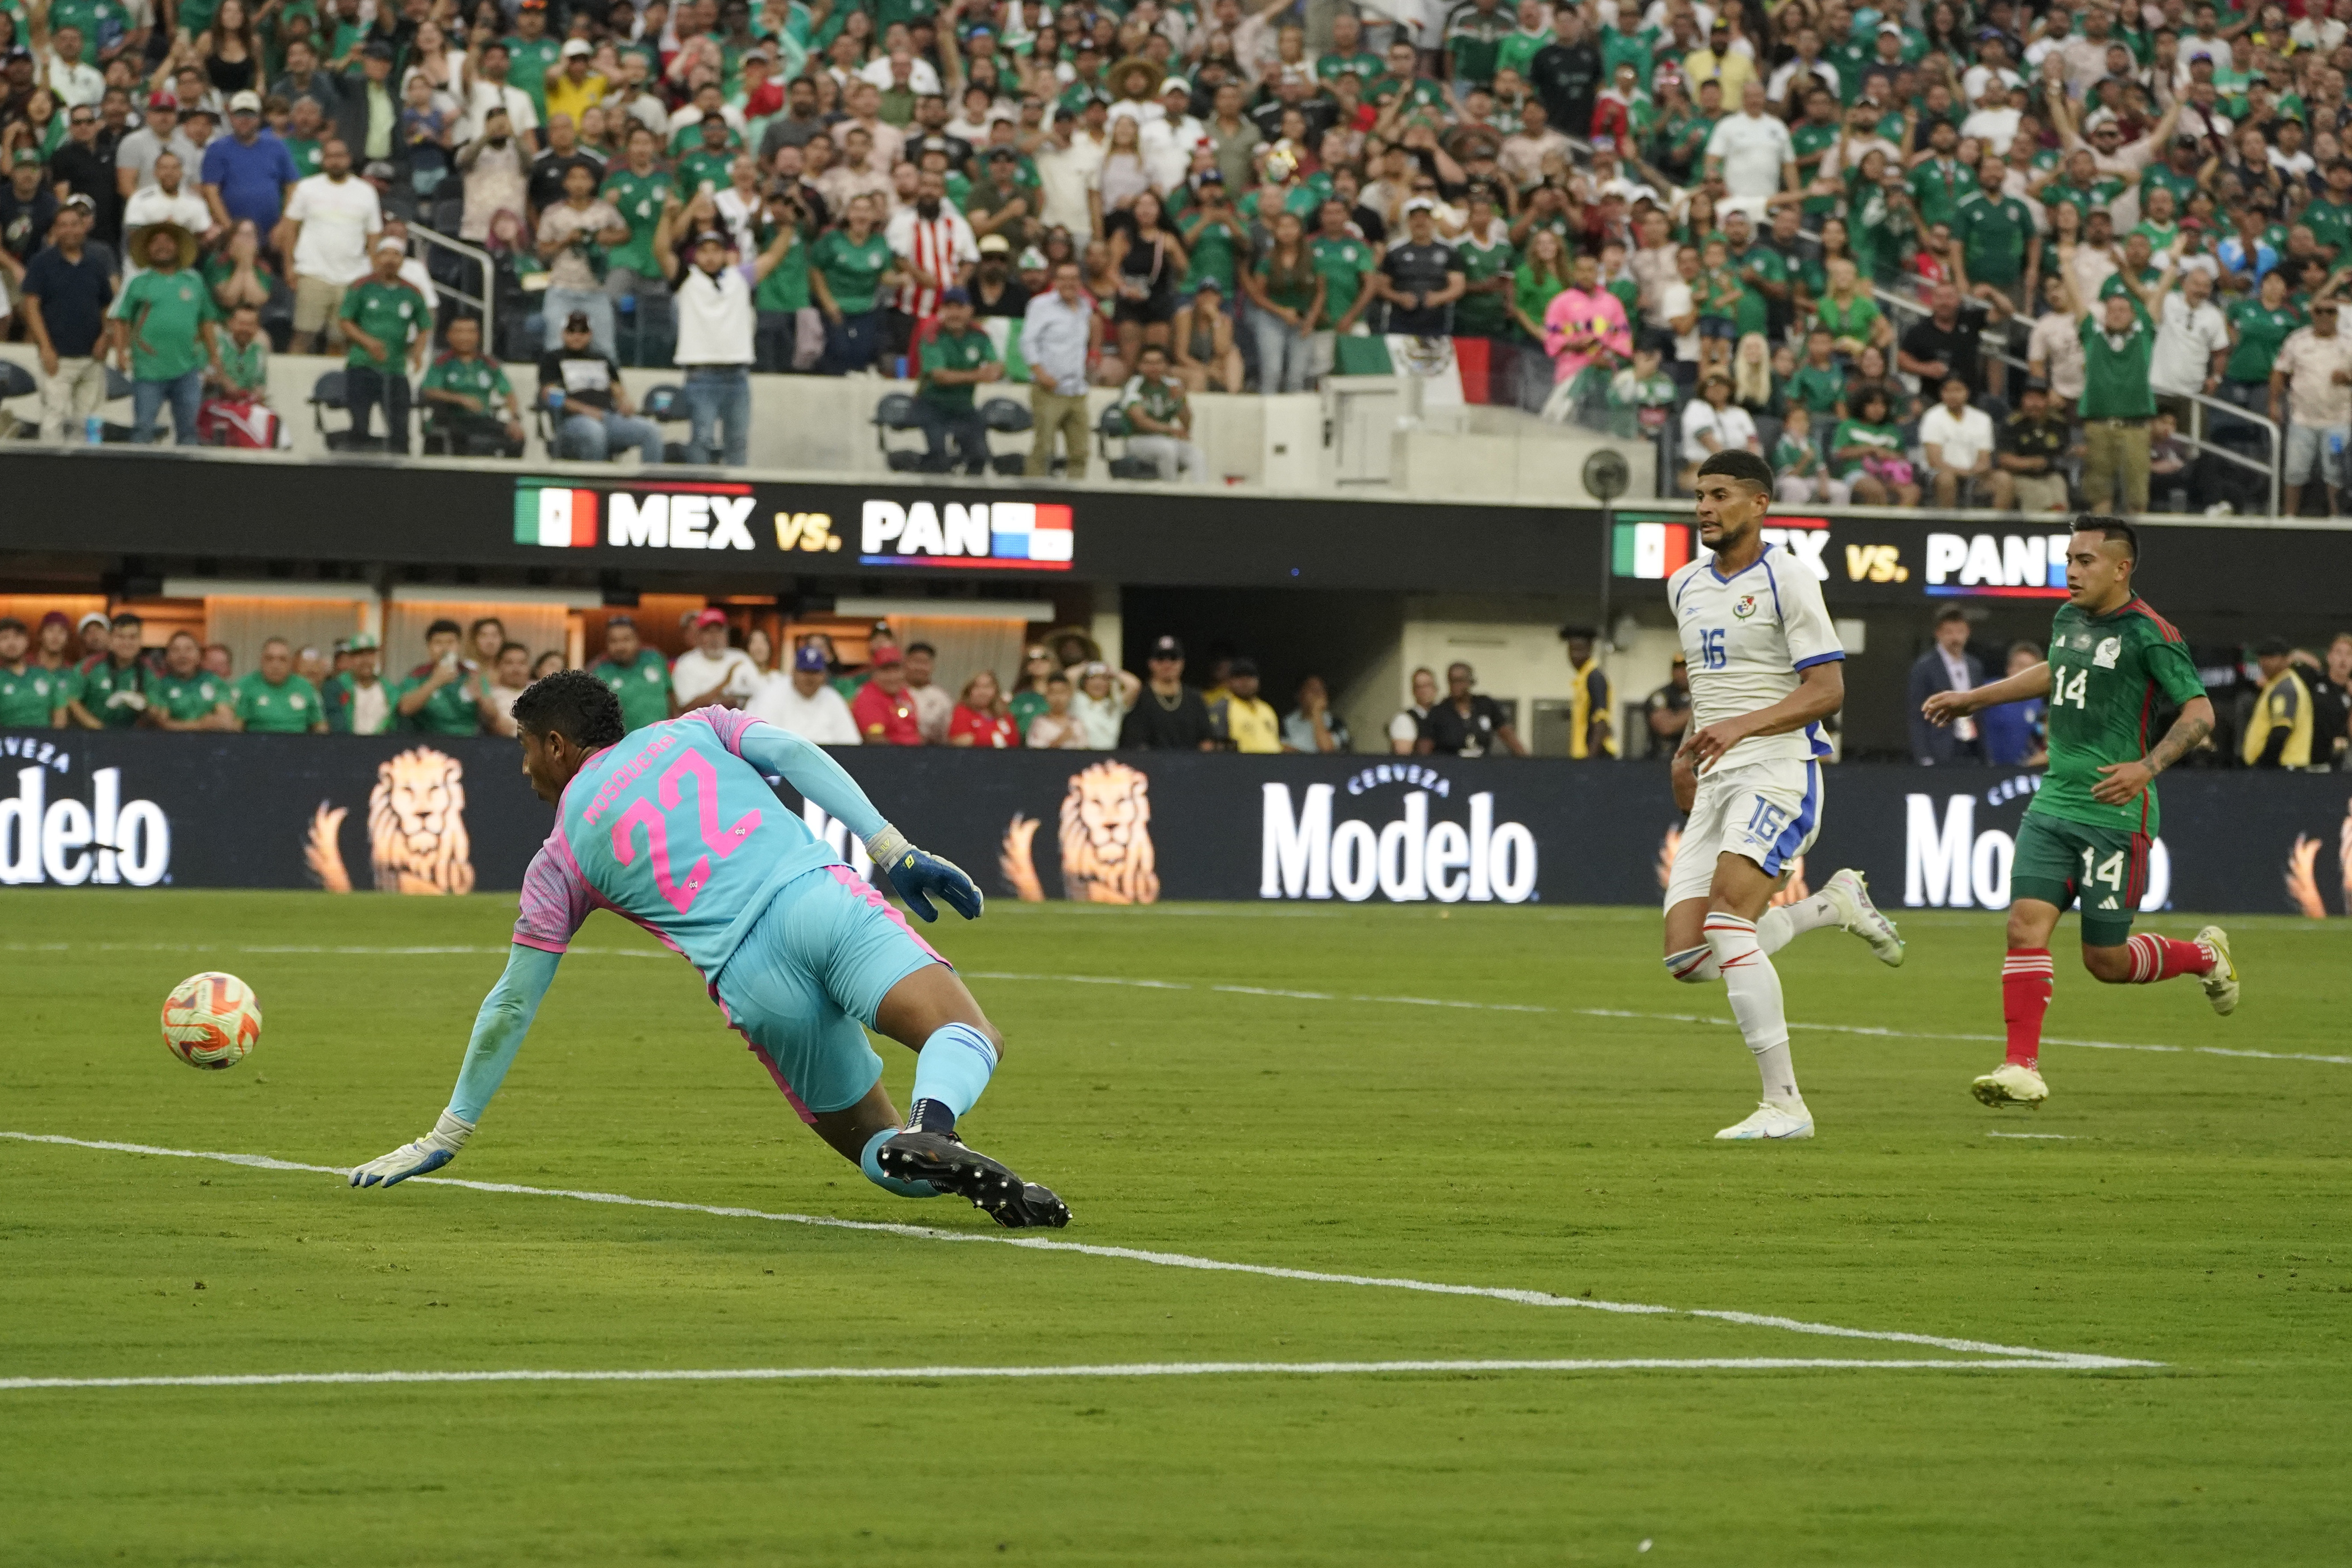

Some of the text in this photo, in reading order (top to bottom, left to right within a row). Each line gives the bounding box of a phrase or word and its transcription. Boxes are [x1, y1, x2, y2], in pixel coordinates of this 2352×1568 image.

[608, 492, 757, 551] MEX
[861, 499, 990, 556] PAN
[1925, 533, 2047, 586] PAN
[1700, 628, 1727, 670] 16
[2053, 665, 2088, 709] 14
[0, 736, 70, 773] VEZA
[583, 735, 677, 826] MOSQUERA
[1347, 763, 1450, 798] CERVEZA
[1987, 774, 2041, 807] CERV
[611, 747, 763, 915] 22
[1748, 794, 1788, 842] 16
[1259, 782, 1537, 902] Modelo
[2082, 846, 2124, 892] 14
